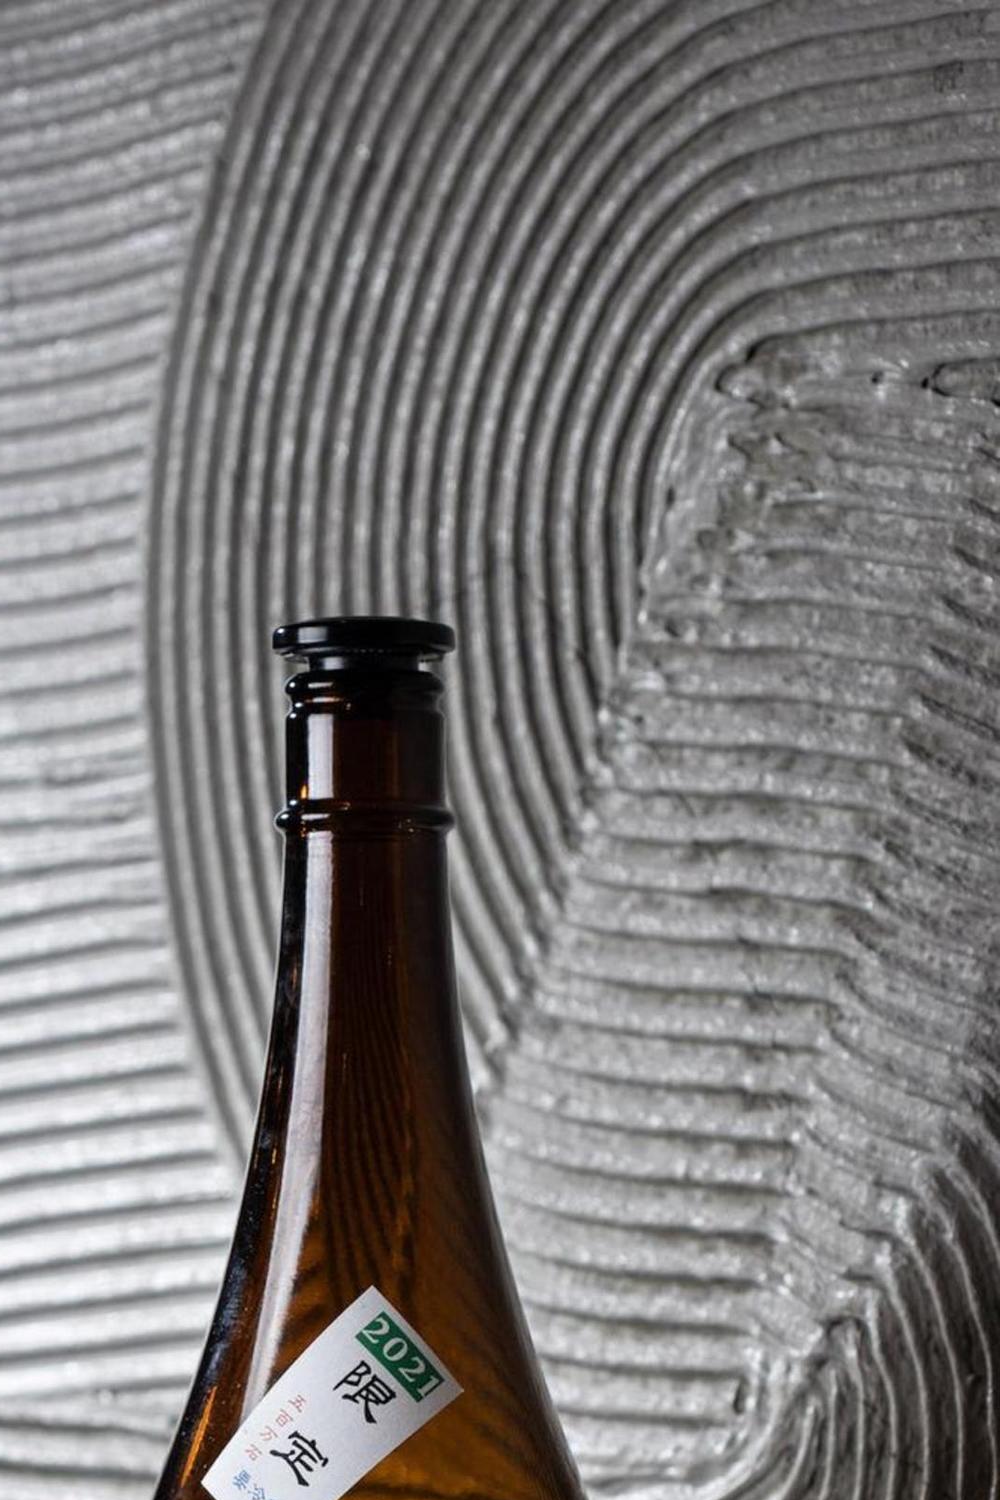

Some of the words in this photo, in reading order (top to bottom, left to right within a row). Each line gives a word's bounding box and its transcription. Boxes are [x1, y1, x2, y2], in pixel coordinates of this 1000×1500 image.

[361, 1316, 441, 1398] 2021
[244, 1393, 308, 1462] 五百万石
[269, 1360, 397, 1488] 限定
